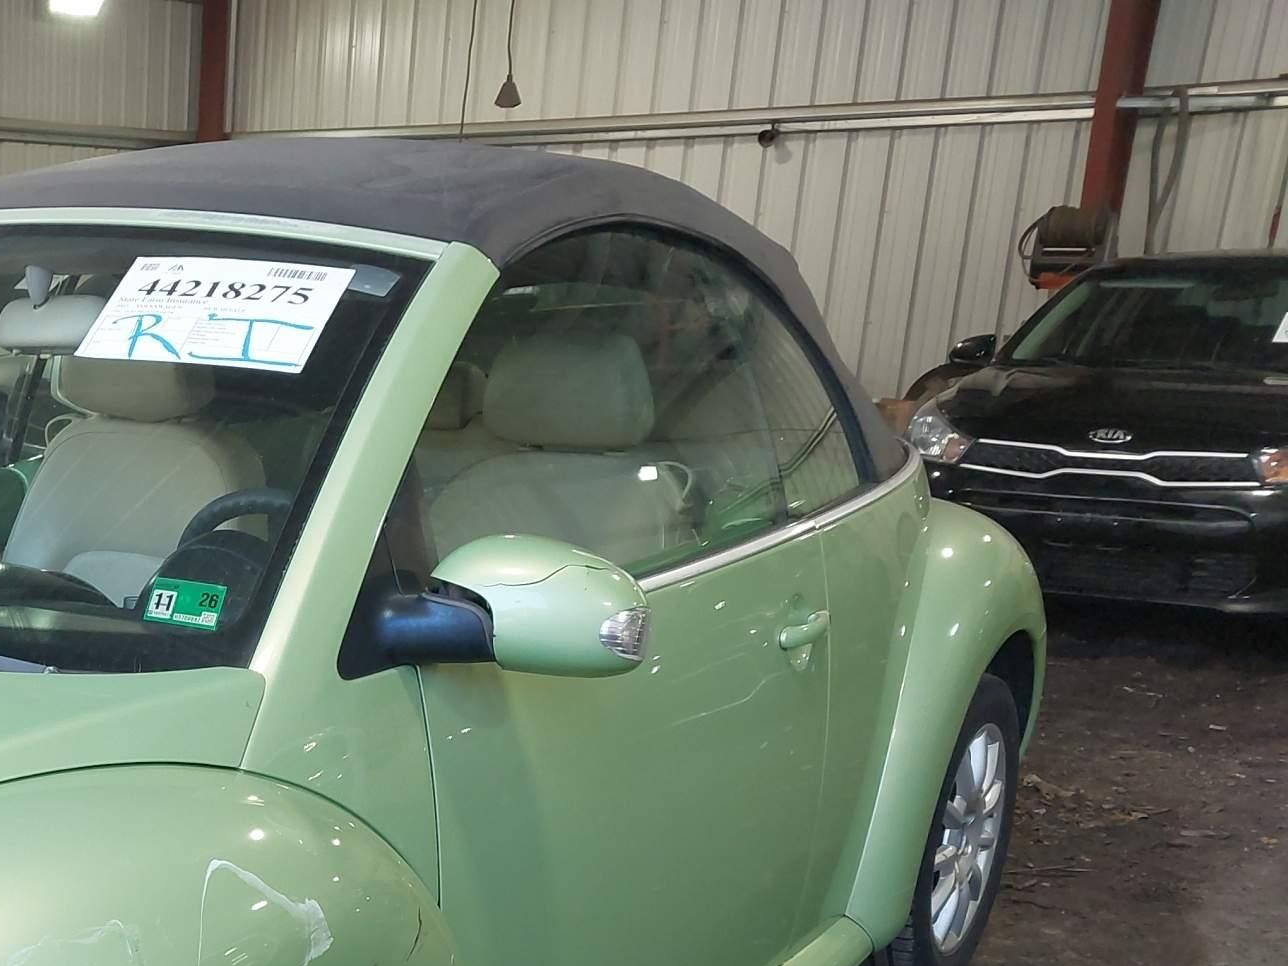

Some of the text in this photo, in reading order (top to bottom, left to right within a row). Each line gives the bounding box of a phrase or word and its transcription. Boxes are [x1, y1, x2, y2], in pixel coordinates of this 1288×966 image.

[138, 278, 315, 305] 44218275
[1095, 428, 1125, 440] KIA
[199, 592, 219, 609] 26
